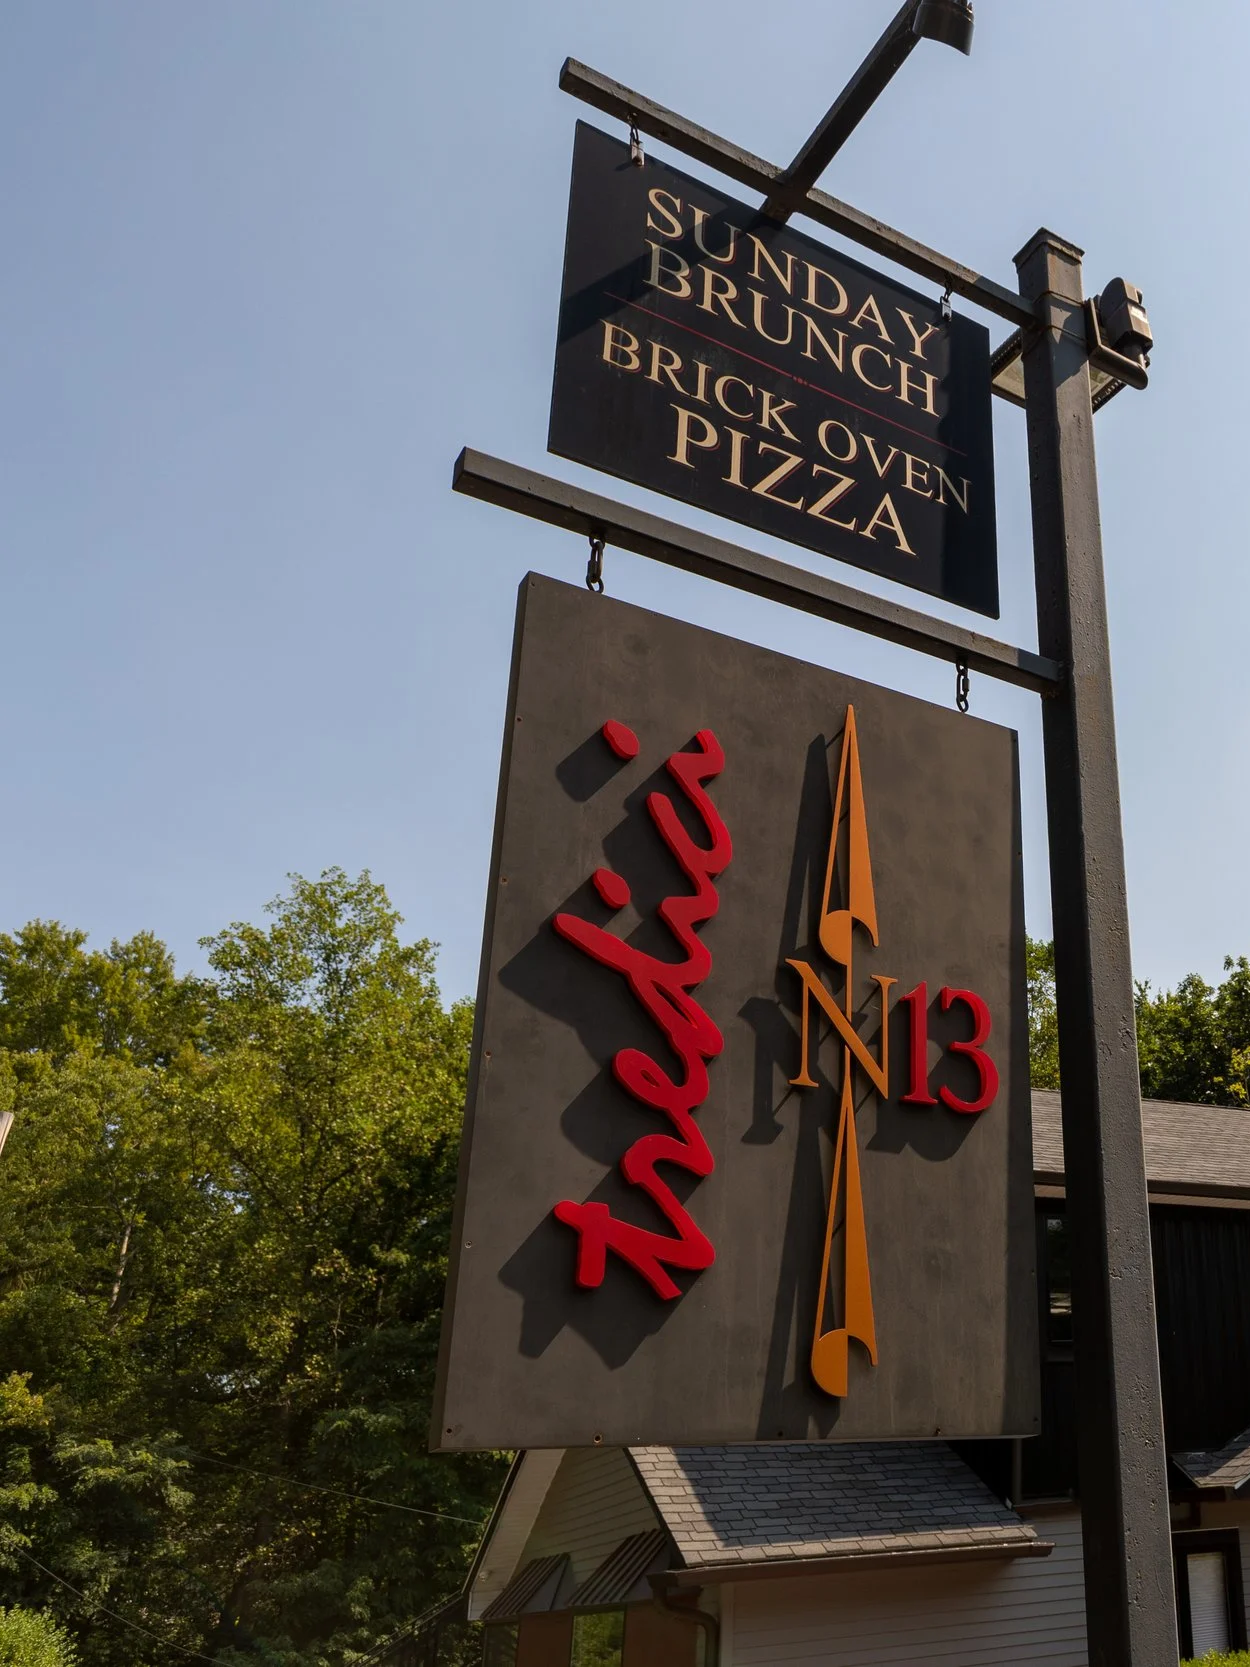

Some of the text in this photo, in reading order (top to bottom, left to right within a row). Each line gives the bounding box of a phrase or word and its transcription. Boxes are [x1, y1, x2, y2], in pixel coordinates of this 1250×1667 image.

[643, 239, 941, 417] BRUNCH
[646, 188, 940, 361] SUNDAY
[601, 319, 972, 515] BRICK OVEN
[666, 404, 917, 555] PIZZA
[554, 720, 732, 1299] tredici
